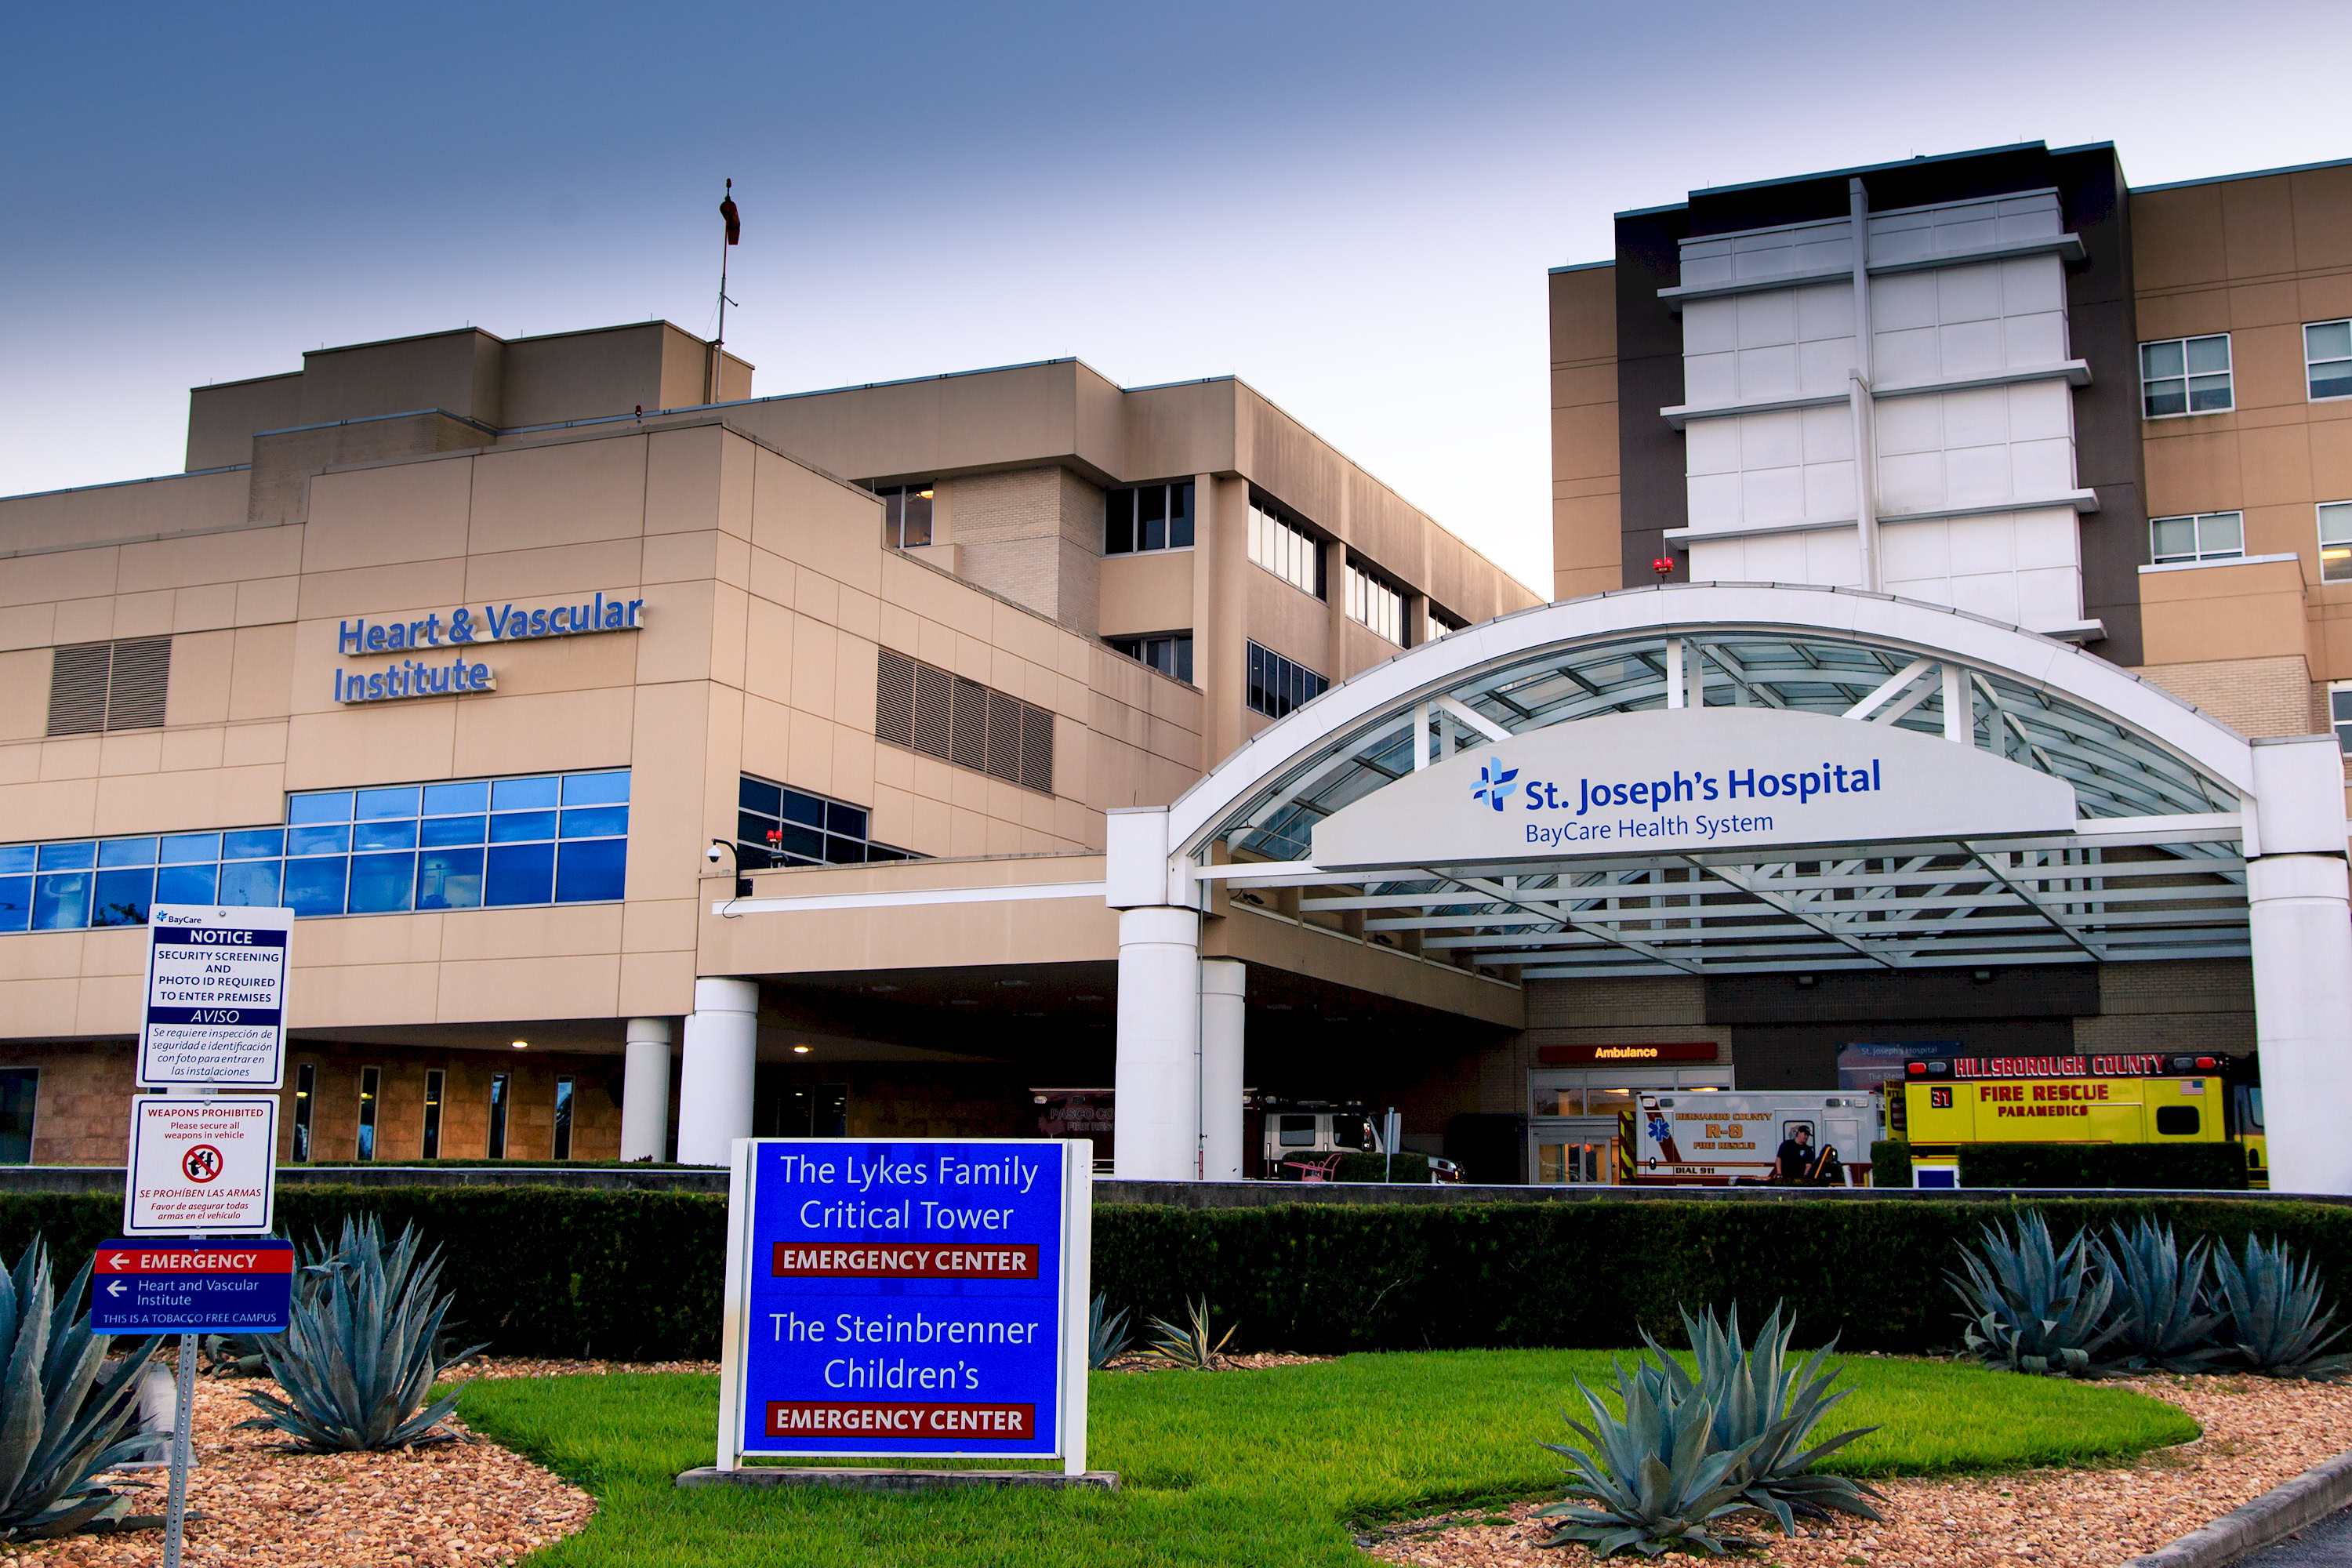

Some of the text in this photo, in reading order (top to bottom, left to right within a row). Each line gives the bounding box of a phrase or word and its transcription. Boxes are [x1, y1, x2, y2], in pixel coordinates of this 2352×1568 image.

[339, 592, 644, 654] Heart & Vascular
[335, 659, 489, 702] Institute
[1526, 759, 1882, 815] St. Joseph’s Hospital
[1526, 813, 1773, 848] BayCare Health System
[169, 916, 201, 925] BayCare
[190, 930, 252, 944] NOTICE
[158, 950, 279, 962] SECURITY SCREENING
[205, 964, 231, 973] AND
[159, 976, 275, 987] PHOTO ID REQUIRED
[161, 992, 271, 1002] TO ENTER PREMISES
[191, 1010, 240, 1023] AVISO
[154, 1028, 272, 1040] Se requiere inspección de
[152, 1040, 199, 1051] seguridad
[208, 1041, 272, 1051] identificación
[1595, 1047, 1658, 1058] Ambulance
[175, 1054, 197, 1065] foto
[198, 1056, 220, 1065] para
[221, 1055, 252, 1064] entrar
[171, 1066, 249, 1076] las instalaciones
[1954, 1054, 2165, 1078] HILLSBOROUGH COUNTY
[1932, 1089, 1951, 1107] 31
[1980, 1086, 2024, 1102] FIRE
[2032, 1084, 2109, 1101] RESCUE
[148, 1109, 263, 1117] WEAPONS PROHIBITED
[1050, 1108, 1115, 1120] PASCO CO
[1998, 1104, 2089, 1117] PARAMEDICS
[1067, 1122, 1114, 1131] FIRE RES
[1706, 1123, 1744, 1138] R-8
[165, 1132, 202, 1141] weapons
[780, 1155, 1039, 1193] The Lykes Family
[140, 1187, 261, 1198] SE PROHÍBEN LAS ARMAS
[188, 1203, 225, 1213] asegurar
[207, 1211, 241, 1220] vehículo
[800, 1200, 1014, 1230] Critical Tower
[140, 1254, 257, 1269] EMERGENCY
[783, 1250, 1027, 1271] EMERGENCY CENTER
[138, 1279, 259, 1291] Heart and Vascular
[137, 1294, 191, 1305] Institute
[103, 1315, 127, 1323] THIS
[130, 1315, 139, 1323] IS
[141, 1315, 149, 1323] A
[151, 1314, 203, 1323] TOBACCO
[232, 1313, 276, 1322] CAMPUS
[769, 1312, 1038, 1344] The Steinbrenner
[824, 1359, 979, 1389] Children’s
[777, 1409, 1023, 1431] EMERGENCY CENTER
